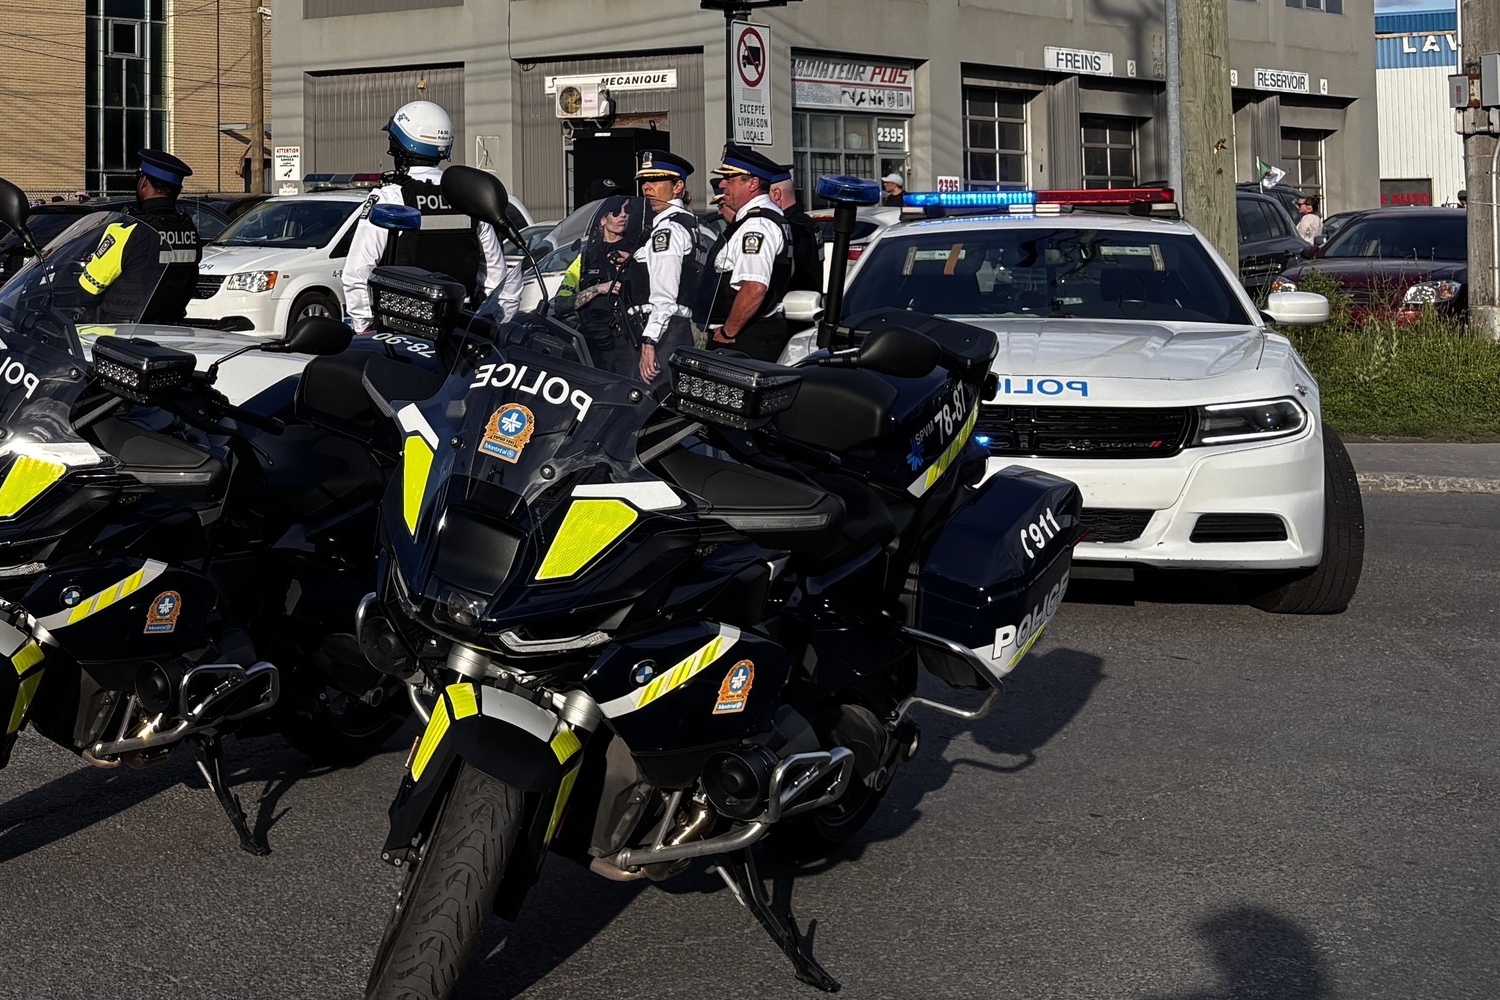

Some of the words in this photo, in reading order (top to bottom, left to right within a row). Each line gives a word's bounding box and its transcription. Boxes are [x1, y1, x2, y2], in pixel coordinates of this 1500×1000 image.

[1056, 52, 1101, 71] FREINS
[794, 59, 866, 81] ADIATEUR
[870, 66, 910, 84] PLUS
[1129, 62, 1136, 75] 2
[601, 74, 668, 86] MECANIQUE
[1231, 71, 1237, 84] 3
[1321, 81, 1327, 92] 4
[740, 104, 766, 115] EXCEPTÉ
[738, 117, 768, 128] LIVRAISON
[743, 131, 765, 142] LOCALE
[878, 127, 904, 142] 2395
[938, 179, 958, 192] 2395
[416, 195, 452, 209] POL
[159, 231, 196, 246] POLICE
[934, 379, 966, 445] 78-87
[915, 420, 934, 445] SPVM
[1029, 507, 1060, 549] 911
